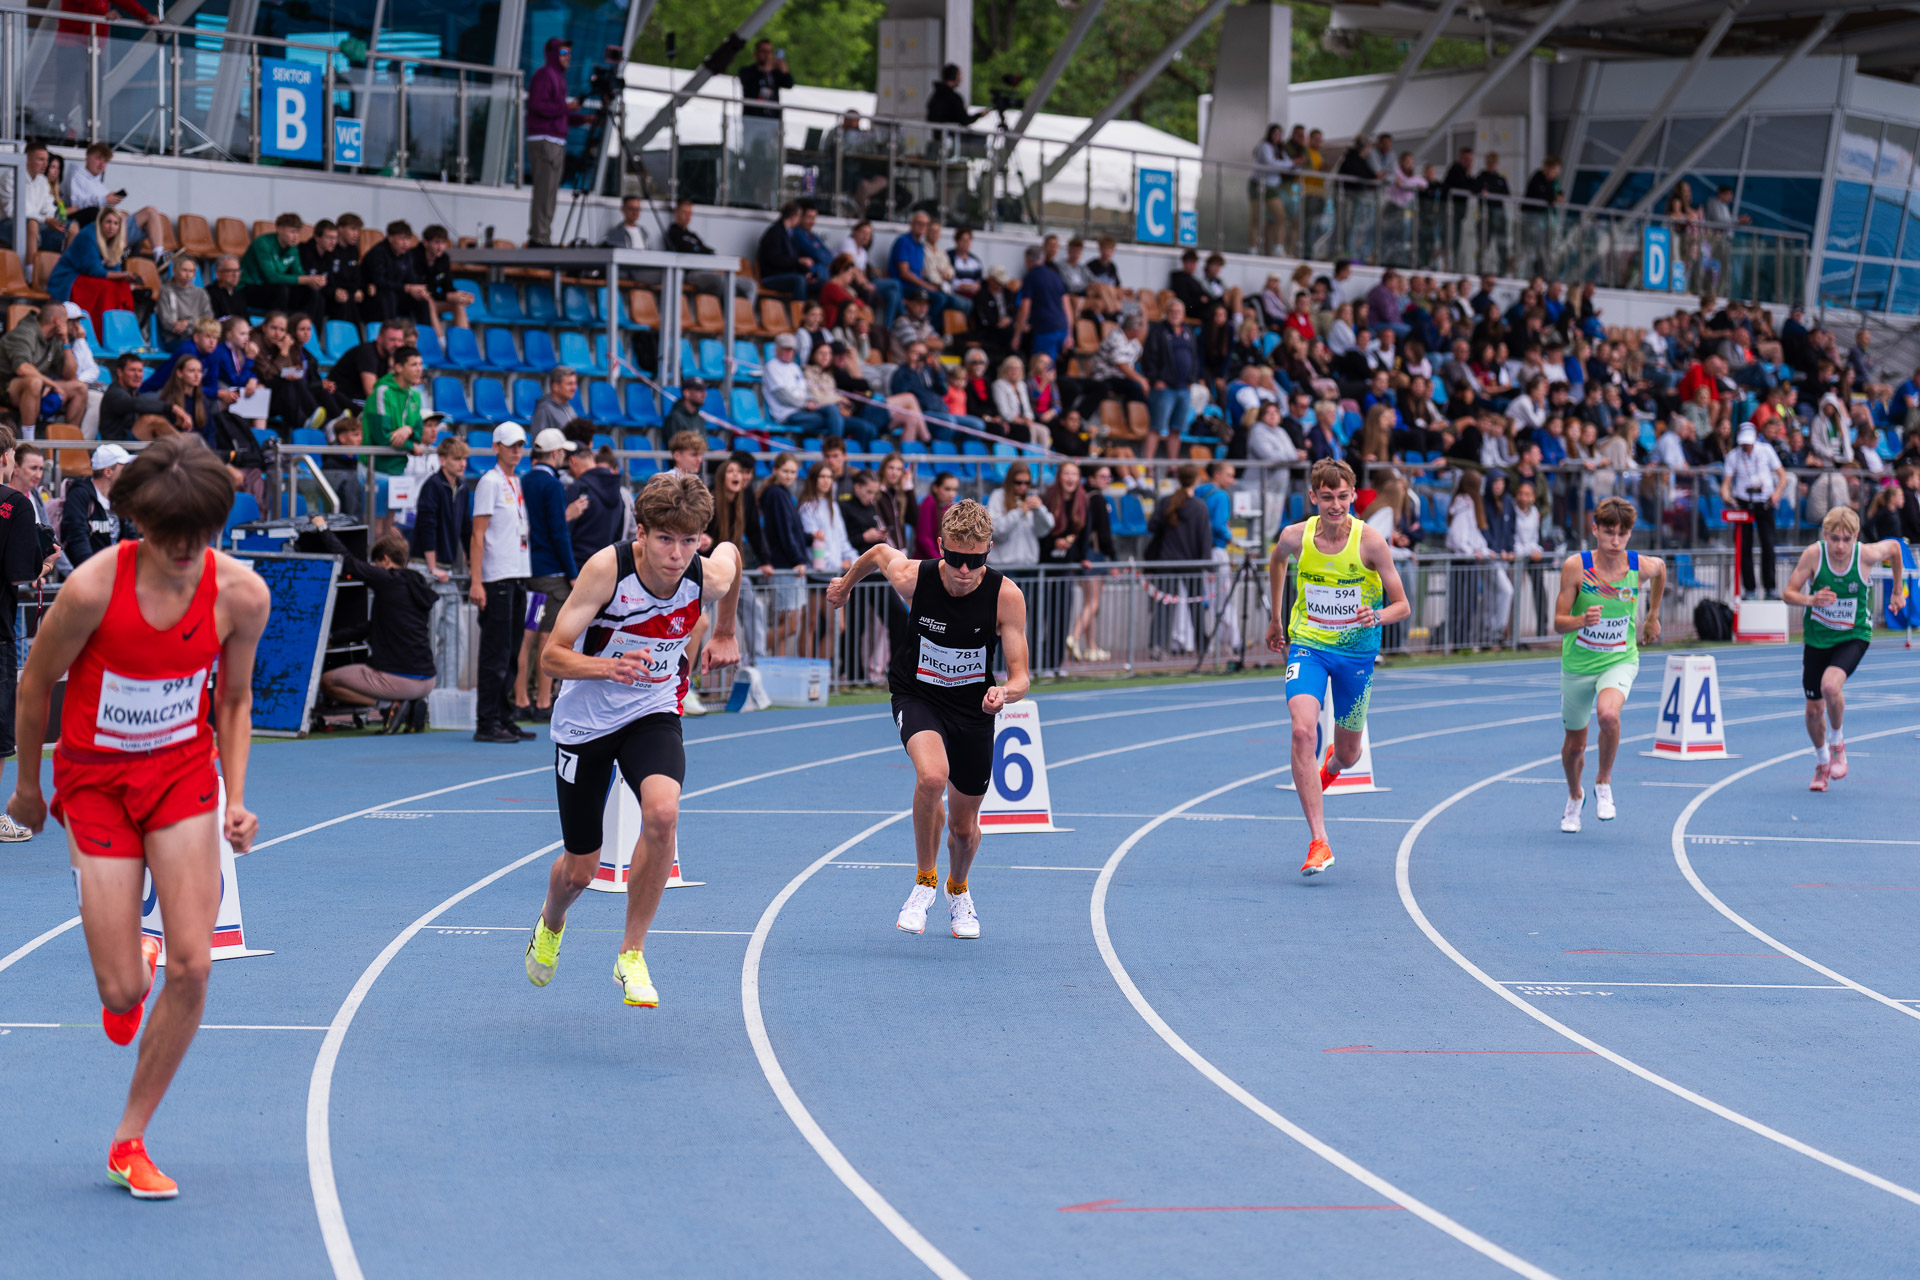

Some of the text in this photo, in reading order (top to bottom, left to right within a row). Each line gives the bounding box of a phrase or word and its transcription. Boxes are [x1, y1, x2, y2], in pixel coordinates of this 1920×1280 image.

[273, 67, 311, 84] SEKTOR
[277, 87, 307, 151] B
[336, 126, 361, 146] WC
[1145, 188, 1165, 237] C
[1649, 244, 1665, 285] D
[1335, 589, 1356, 599] 594
[919, 616, 935, 624] JUST
[928, 623, 946, 632] TEAM
[1583, 627, 1623, 640] BANIAK
[655, 640, 684, 653] 507
[955, 650, 980, 660] 781
[611, 651, 668, 672] BDA
[921, 653, 983, 674] PIECHOTA
[1286, 665, 1295, 680] 5
[162, 676, 194, 697] 991
[102, 696, 195, 726] KOWALCZYK
[1662, 676, 1681, 735] 4
[1691, 676, 1716, 735] 4
[560, 752, 572, 777] 7
[992, 726, 1034, 802] 6
